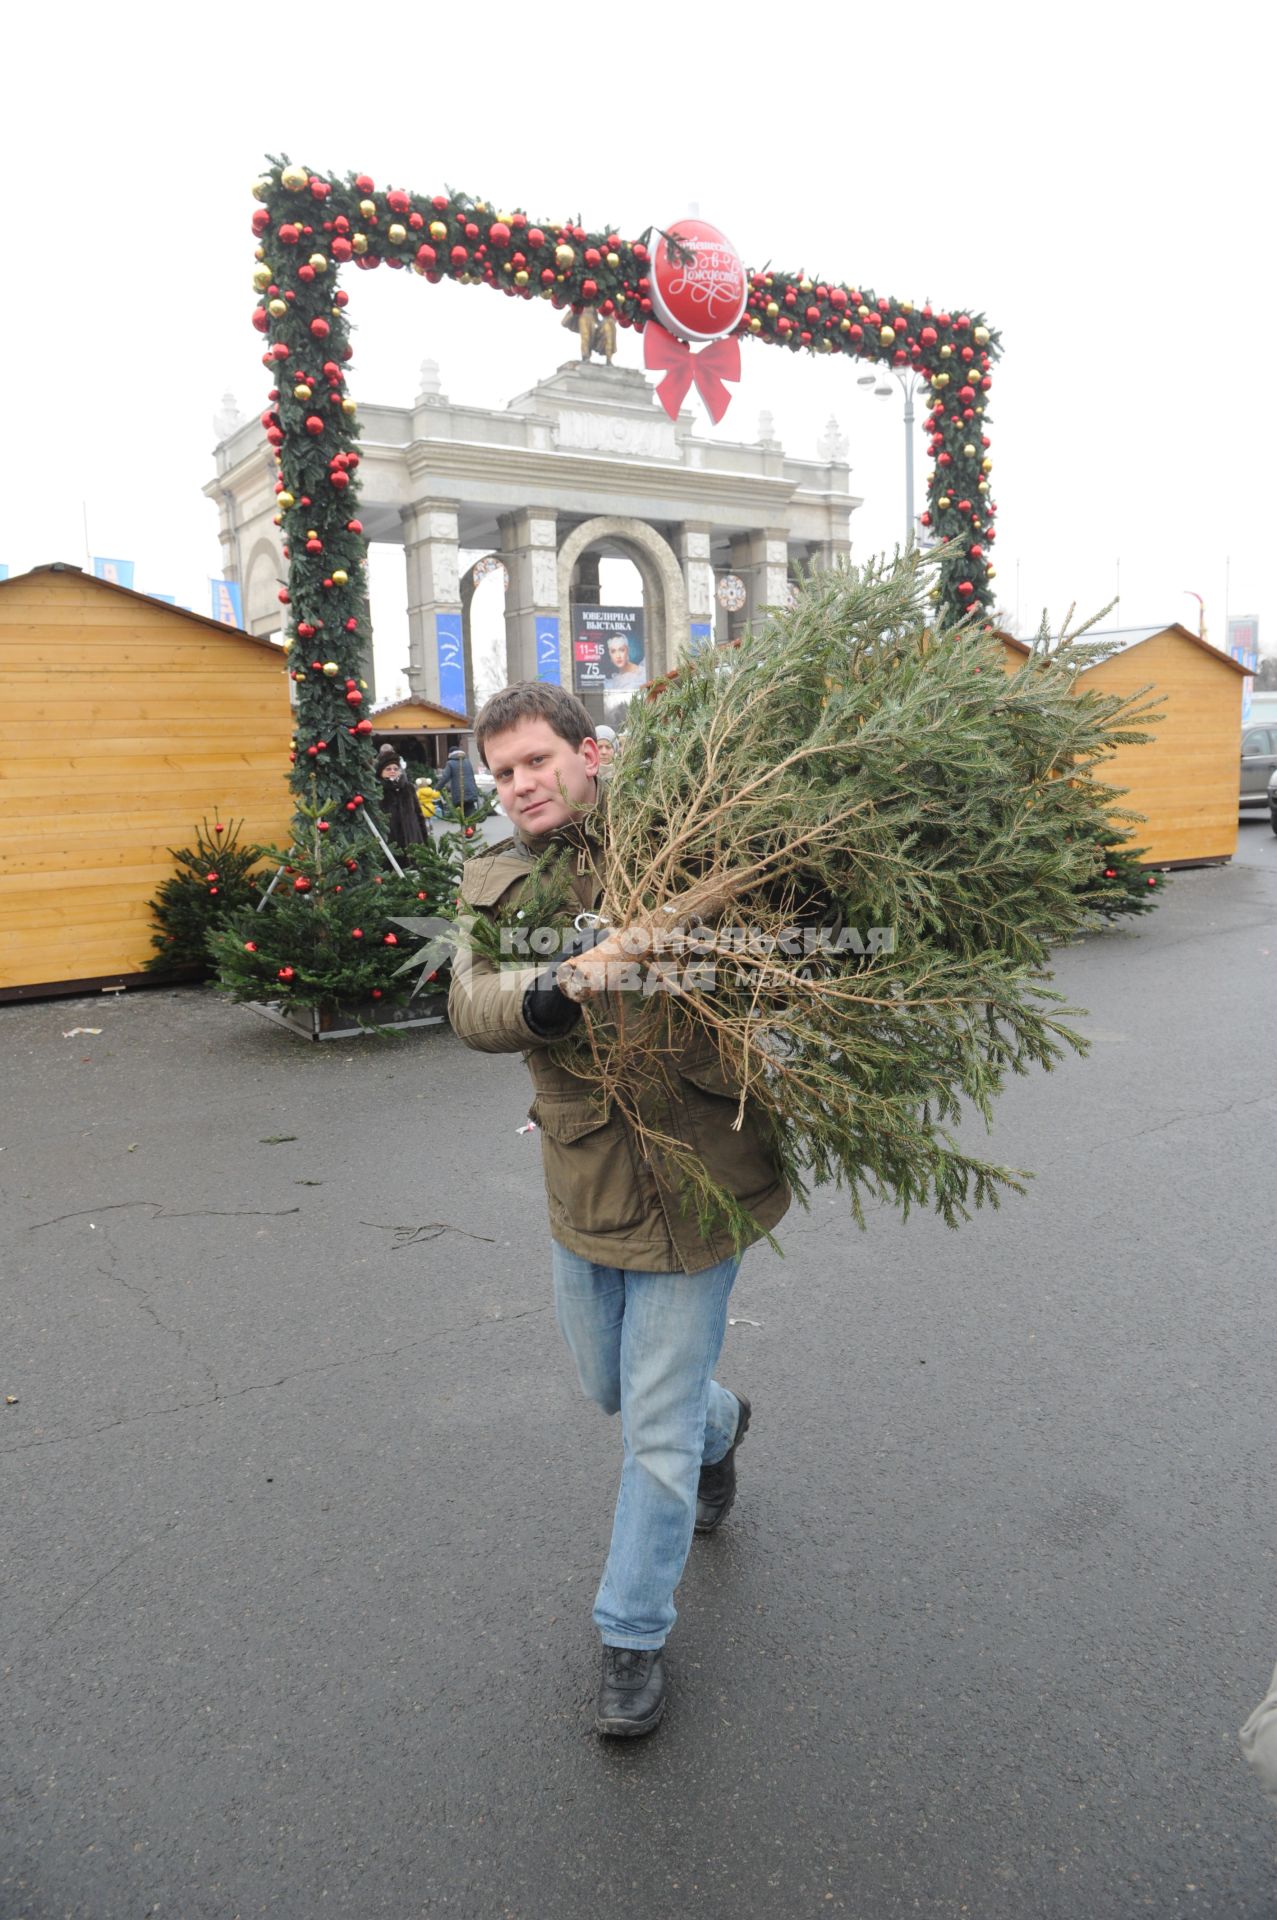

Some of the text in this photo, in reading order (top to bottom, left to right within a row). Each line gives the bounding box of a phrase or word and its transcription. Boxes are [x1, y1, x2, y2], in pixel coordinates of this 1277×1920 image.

[582, 612, 635, 621] ЮВЕЛИРНАЯ
[586, 621, 632, 631] ВЫСТАВКА
[585, 662, 600, 675] 75
